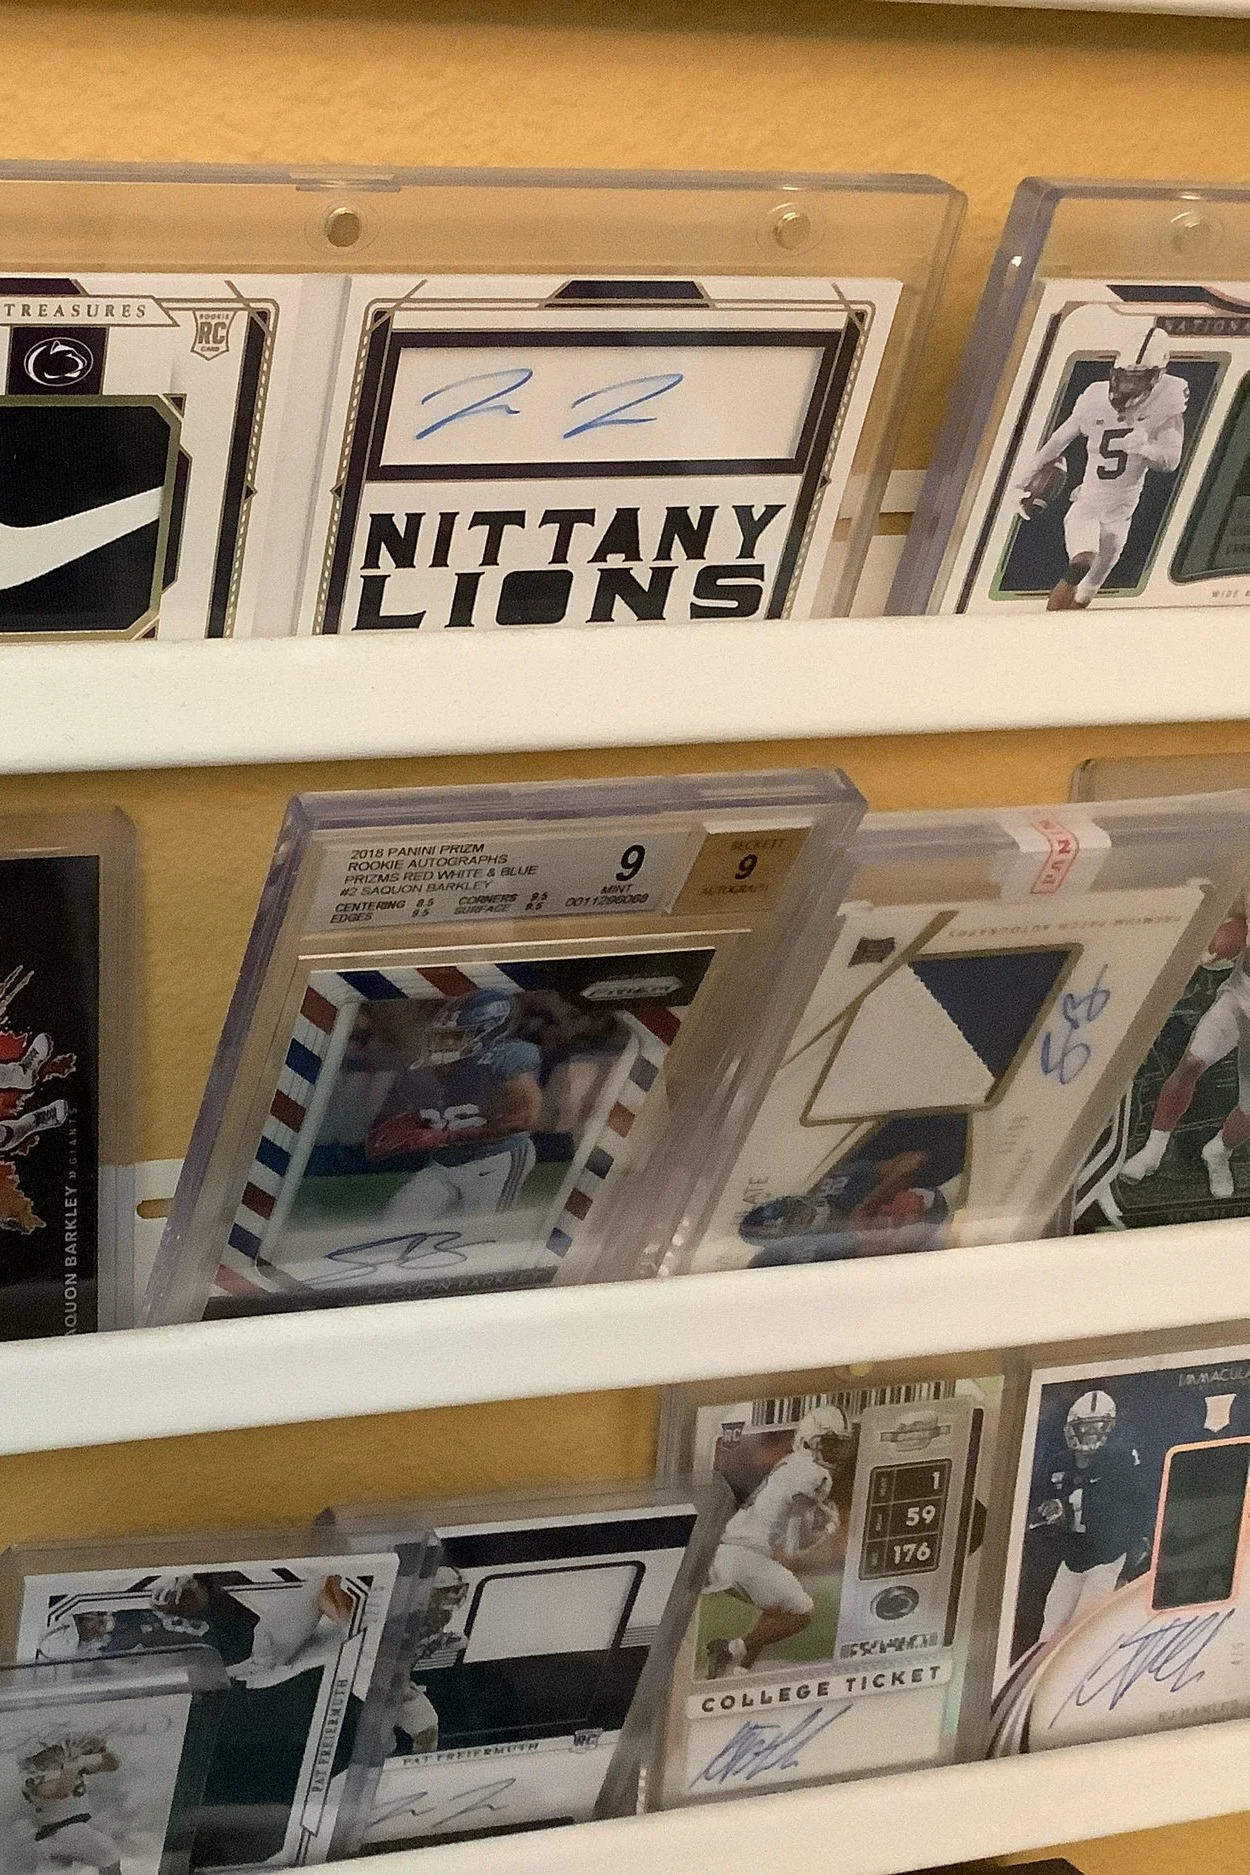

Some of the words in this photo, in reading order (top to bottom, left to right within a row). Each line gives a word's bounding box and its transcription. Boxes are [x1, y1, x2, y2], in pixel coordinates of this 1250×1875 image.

[2, 303, 148, 319] TREASURES
[197, 321, 227, 345] RC
[1096, 427, 1135, 480] 5
[360, 503, 787, 570] NITTANY
[352, 563, 766, 631] LIONS
[347, 859, 405, 872] ROOKIE
[407, 853, 509, 869] AUTOGRAPHS
[350, 848, 385, 861] 2018
[387, 845, 436, 858] PANINI
[439, 843, 486, 855] PRIZM
[615, 844, 646, 882] 9
[343, 872, 400, 885] PRIZMS
[402, 870, 434, 882] RED
[437, 868, 483, 880] WHITE
[486, 867, 496, 878] &
[499, 864, 539, 877] BLUE
[734, 853, 758, 880] 9
[339, 886, 358, 898] #2
[360, 883, 424, 896] SAQUON
[426, 880, 493, 892] BARKLEY
[600, 883, 634, 895] MINT
[329, 911, 373, 924] EDGES
[453, 903, 512, 916] SURFACE
[334, 899, 406, 913] CENTERING
[457, 892, 519, 906] CORNERS
[68, 1106, 79, 1166] GIANTS
[64, 1186, 78, 1267] BARKLEY
[931, 1470, 941, 1491] 1
[905, 1503, 937, 1528] 59
[892, 1541, 932, 1565] 176
[701, 1680, 831, 1714] COLLEGE
[845, 1664, 942, 1693] TICKET
[402, 1754, 430, 1766] PAT
